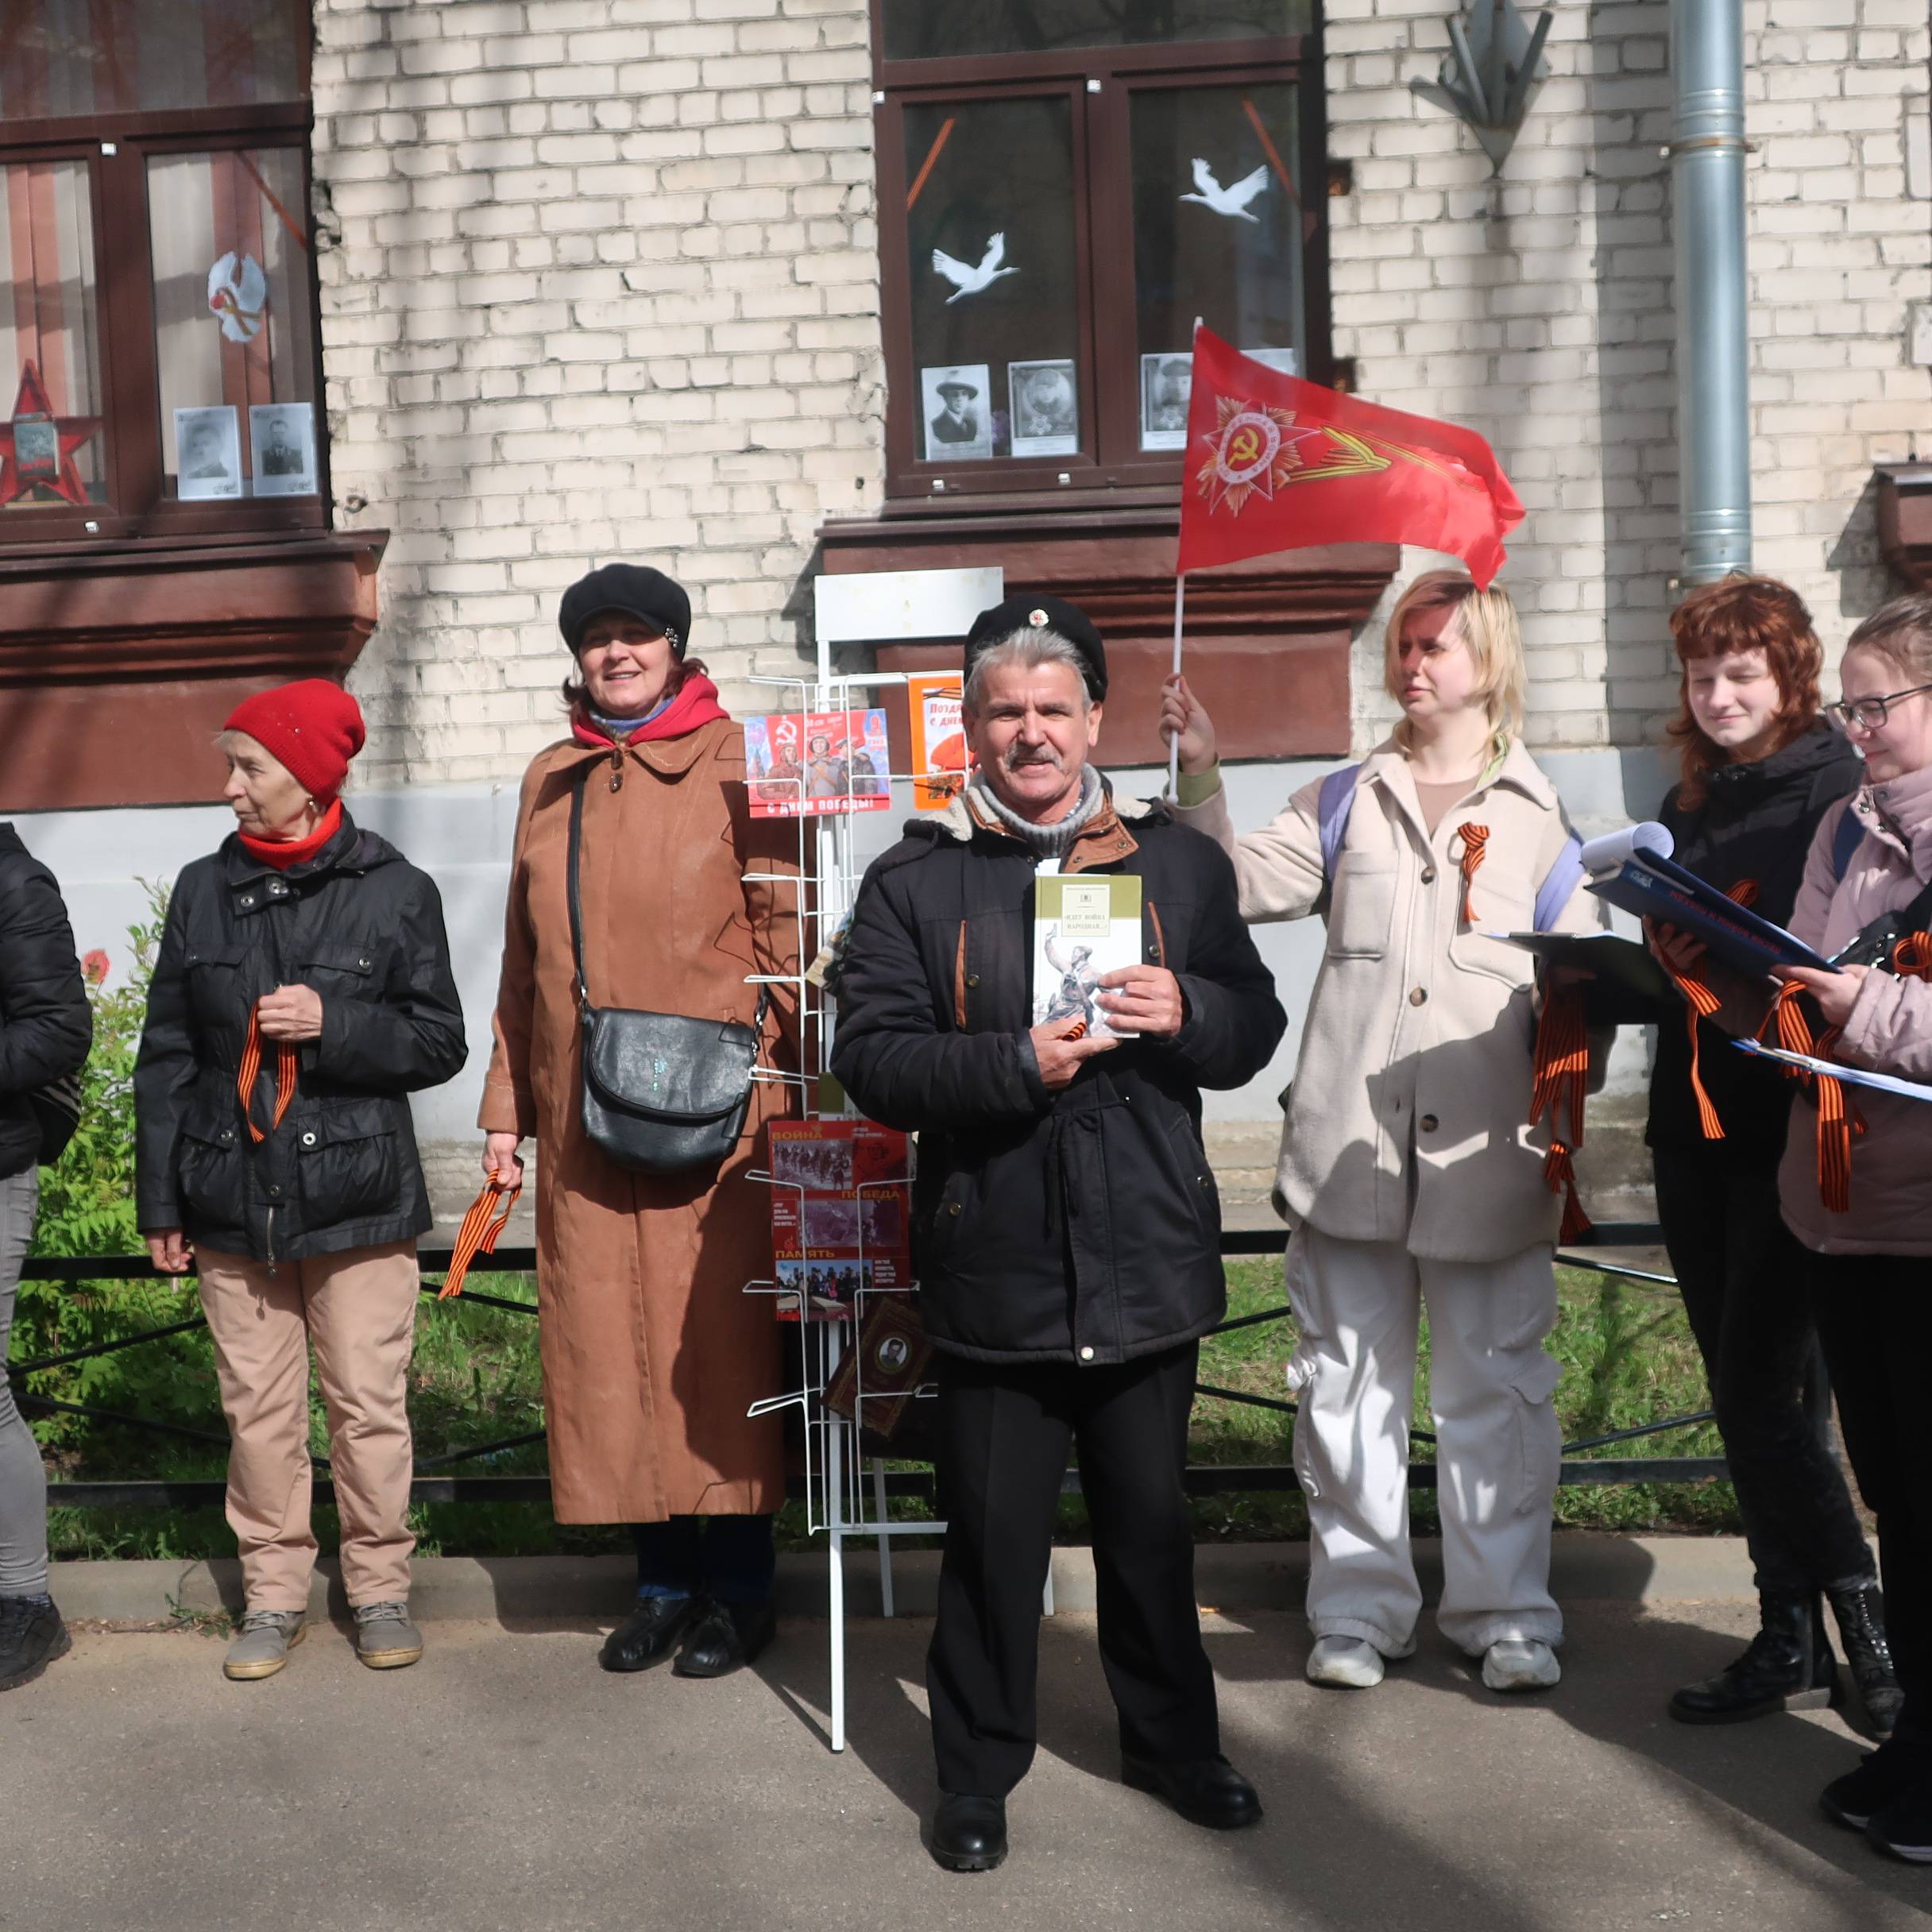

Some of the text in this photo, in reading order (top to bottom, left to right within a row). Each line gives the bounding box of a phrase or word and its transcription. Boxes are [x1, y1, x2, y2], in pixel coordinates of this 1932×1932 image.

[767, 802, 775, 814] С
[772, 1130, 823, 1142] ВОЙНА
[842, 1190, 900, 1201] ПОБЕДА
[775, 1250, 834, 1261] ПАМЯТЬ
